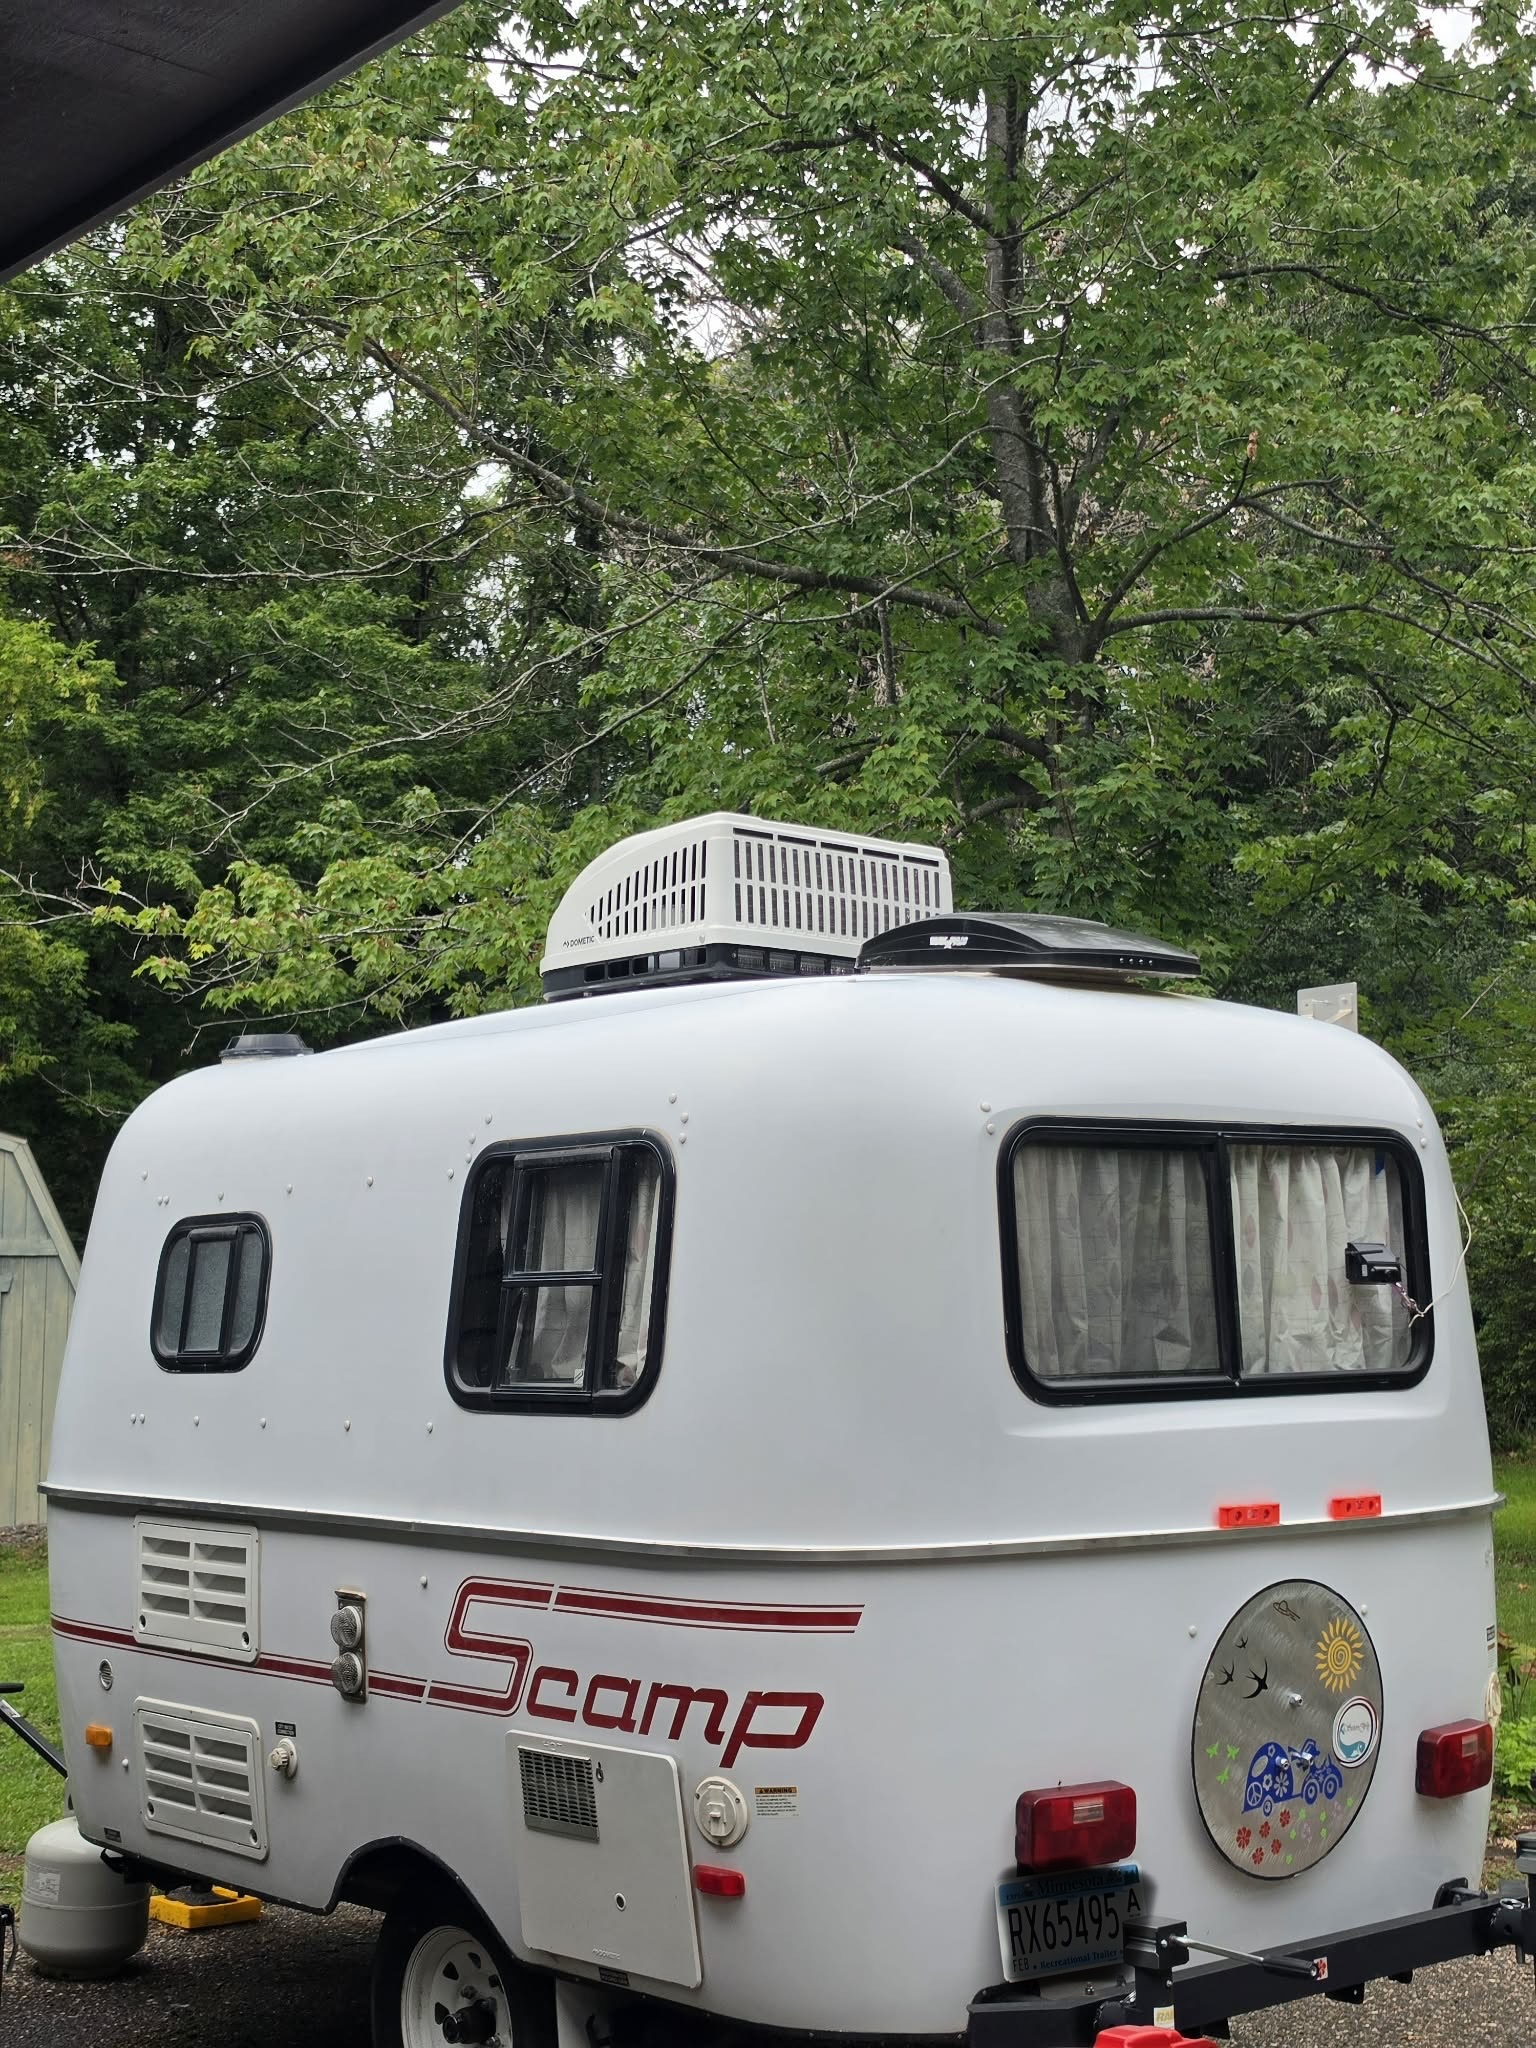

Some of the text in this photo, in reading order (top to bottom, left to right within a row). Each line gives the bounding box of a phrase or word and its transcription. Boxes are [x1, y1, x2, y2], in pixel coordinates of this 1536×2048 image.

[570, 936, 594, 947] DOMETIC
[432, 1575, 825, 1768] Scamp
[1008, 1888, 1140, 1957] RX65495 A
[1013, 1948, 1117, 1972] FEB Recreational Trailer
